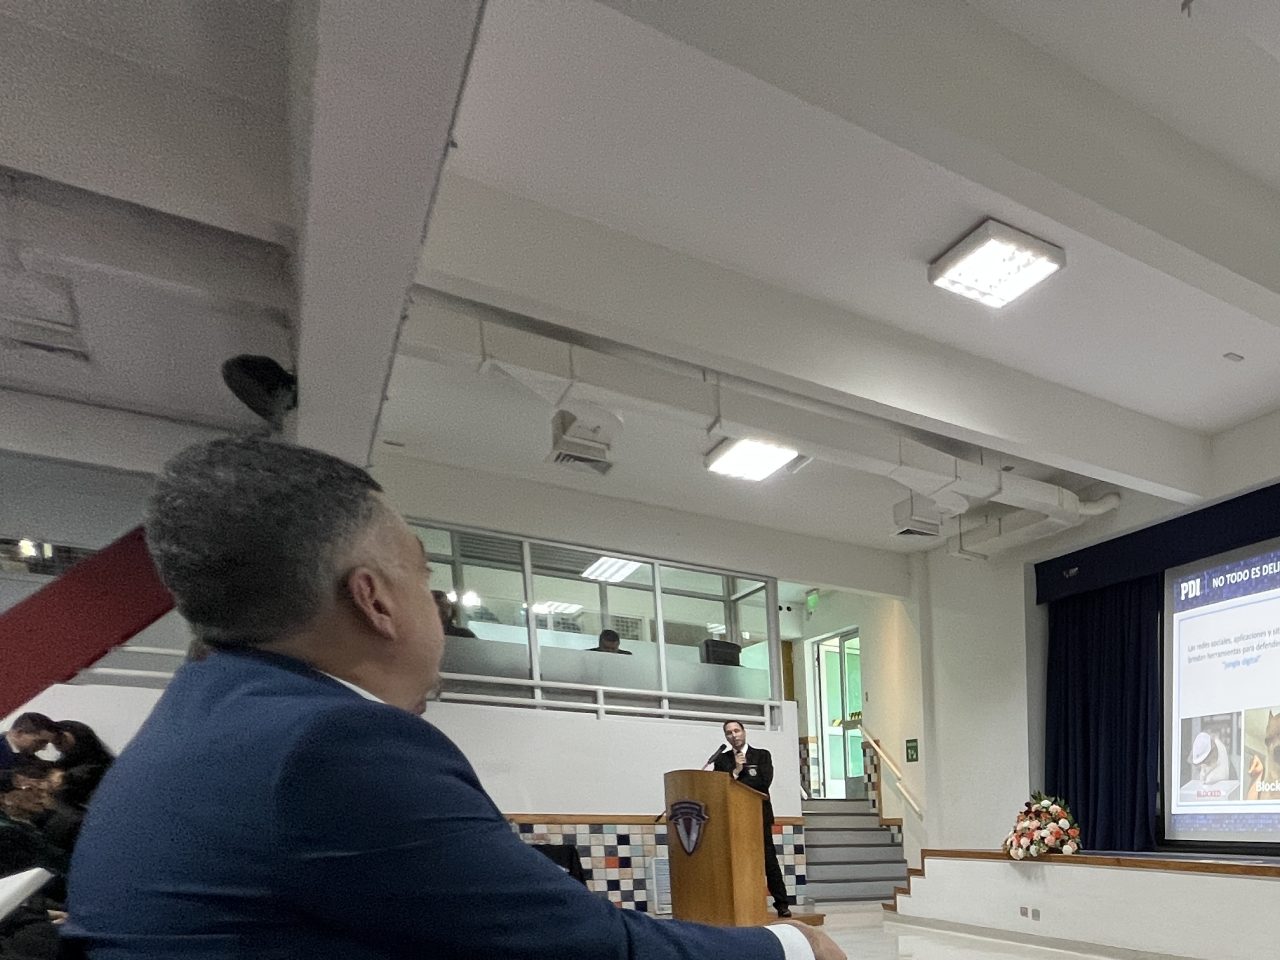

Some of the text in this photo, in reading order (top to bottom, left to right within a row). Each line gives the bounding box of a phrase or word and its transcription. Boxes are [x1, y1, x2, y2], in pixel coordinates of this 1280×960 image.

[1212, 576, 1225, 589] NO
[1225, 569, 1249, 585] TODO
[1251, 566, 1261, 579] ES
[1180, 578, 1201, 601] PDI
